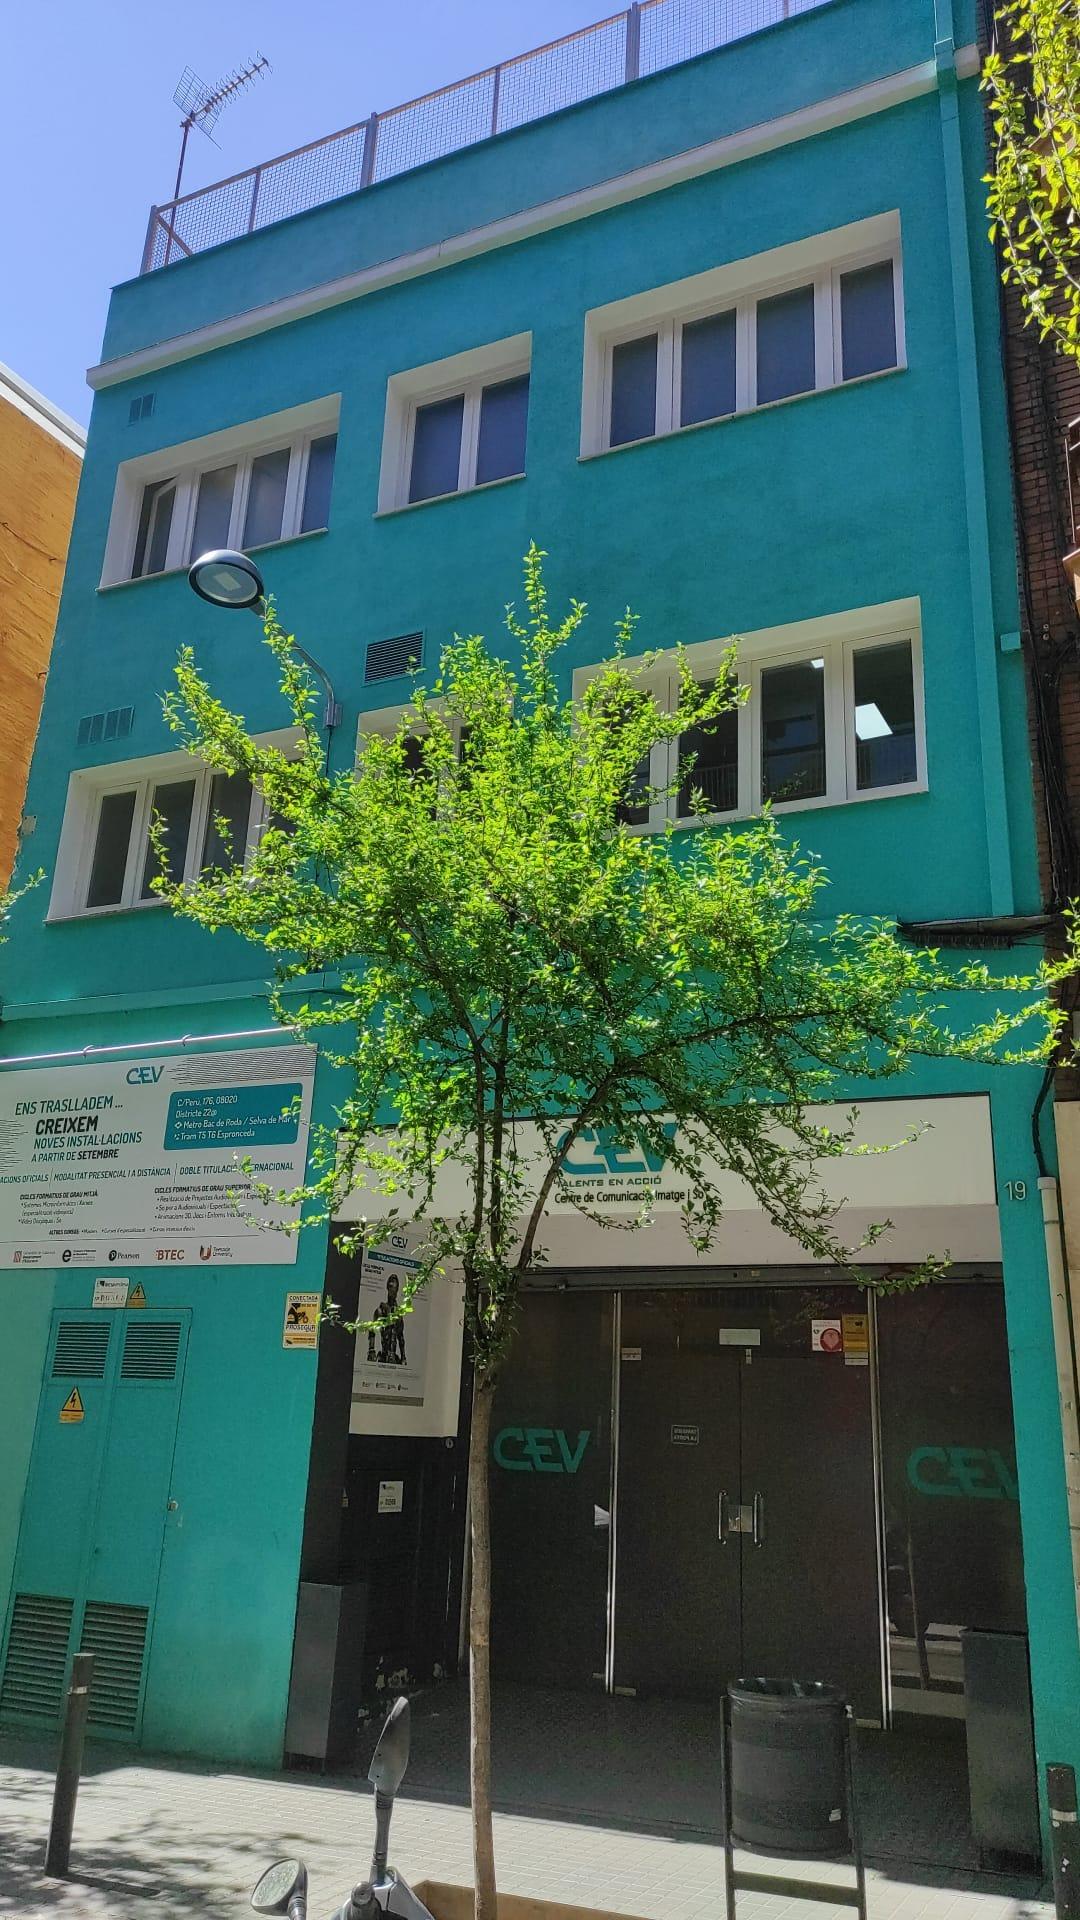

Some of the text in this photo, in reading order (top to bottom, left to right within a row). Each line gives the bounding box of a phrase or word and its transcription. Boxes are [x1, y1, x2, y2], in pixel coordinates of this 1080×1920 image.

[126, 1066, 165, 1085] CEV
[216, 1095, 238, 1105] 08020
[15, 1101, 37, 1115] ENS
[175, 1110, 202, 1119] Districte
[35, 1115, 99, 1135] CREIXEM
[183, 1120, 201, 1129] Metro
[203, 1119, 215, 1128] Bac
[216, 1119, 225, 1127] de
[226, 1118, 242, 1126] Roda
[249, 1116, 267, 1125] Selva
[268, 1115, 277, 1124] de
[181, 1132, 197, 1140] Tram
[217, 1128, 255, 1138] Espronceda
[33, 1136, 65, 1150] NOVES
[31, 1148, 120, 1163] A PARTIR DE SETEMBRE
[54, 1172, 88, 1181] MODALITAT
[89, 1170, 126, 1180] PRESENCIAL
[132, 1169, 137, 1177] A
[180, 1166, 201, 1175] DOBLE
[608, 1178, 624, 1186] EN
[626, 1175, 662, 1186] ACCIÓ
[555, 1192, 582, 1204] Centre
[583, 1191, 595, 1203] de
[655, 1190, 685, 1203] Imatge
[687, 1188, 691, 1200] i
[693, 1186, 704, 1200] So
[1004, 1180, 1026, 1201] 19
[392, 1235, 409, 1249] CEV
[117, 1252, 140, 1260] Pearson
[156, 1249, 185, 1261] BTEC
[493, 1427, 591, 1473] CEV
